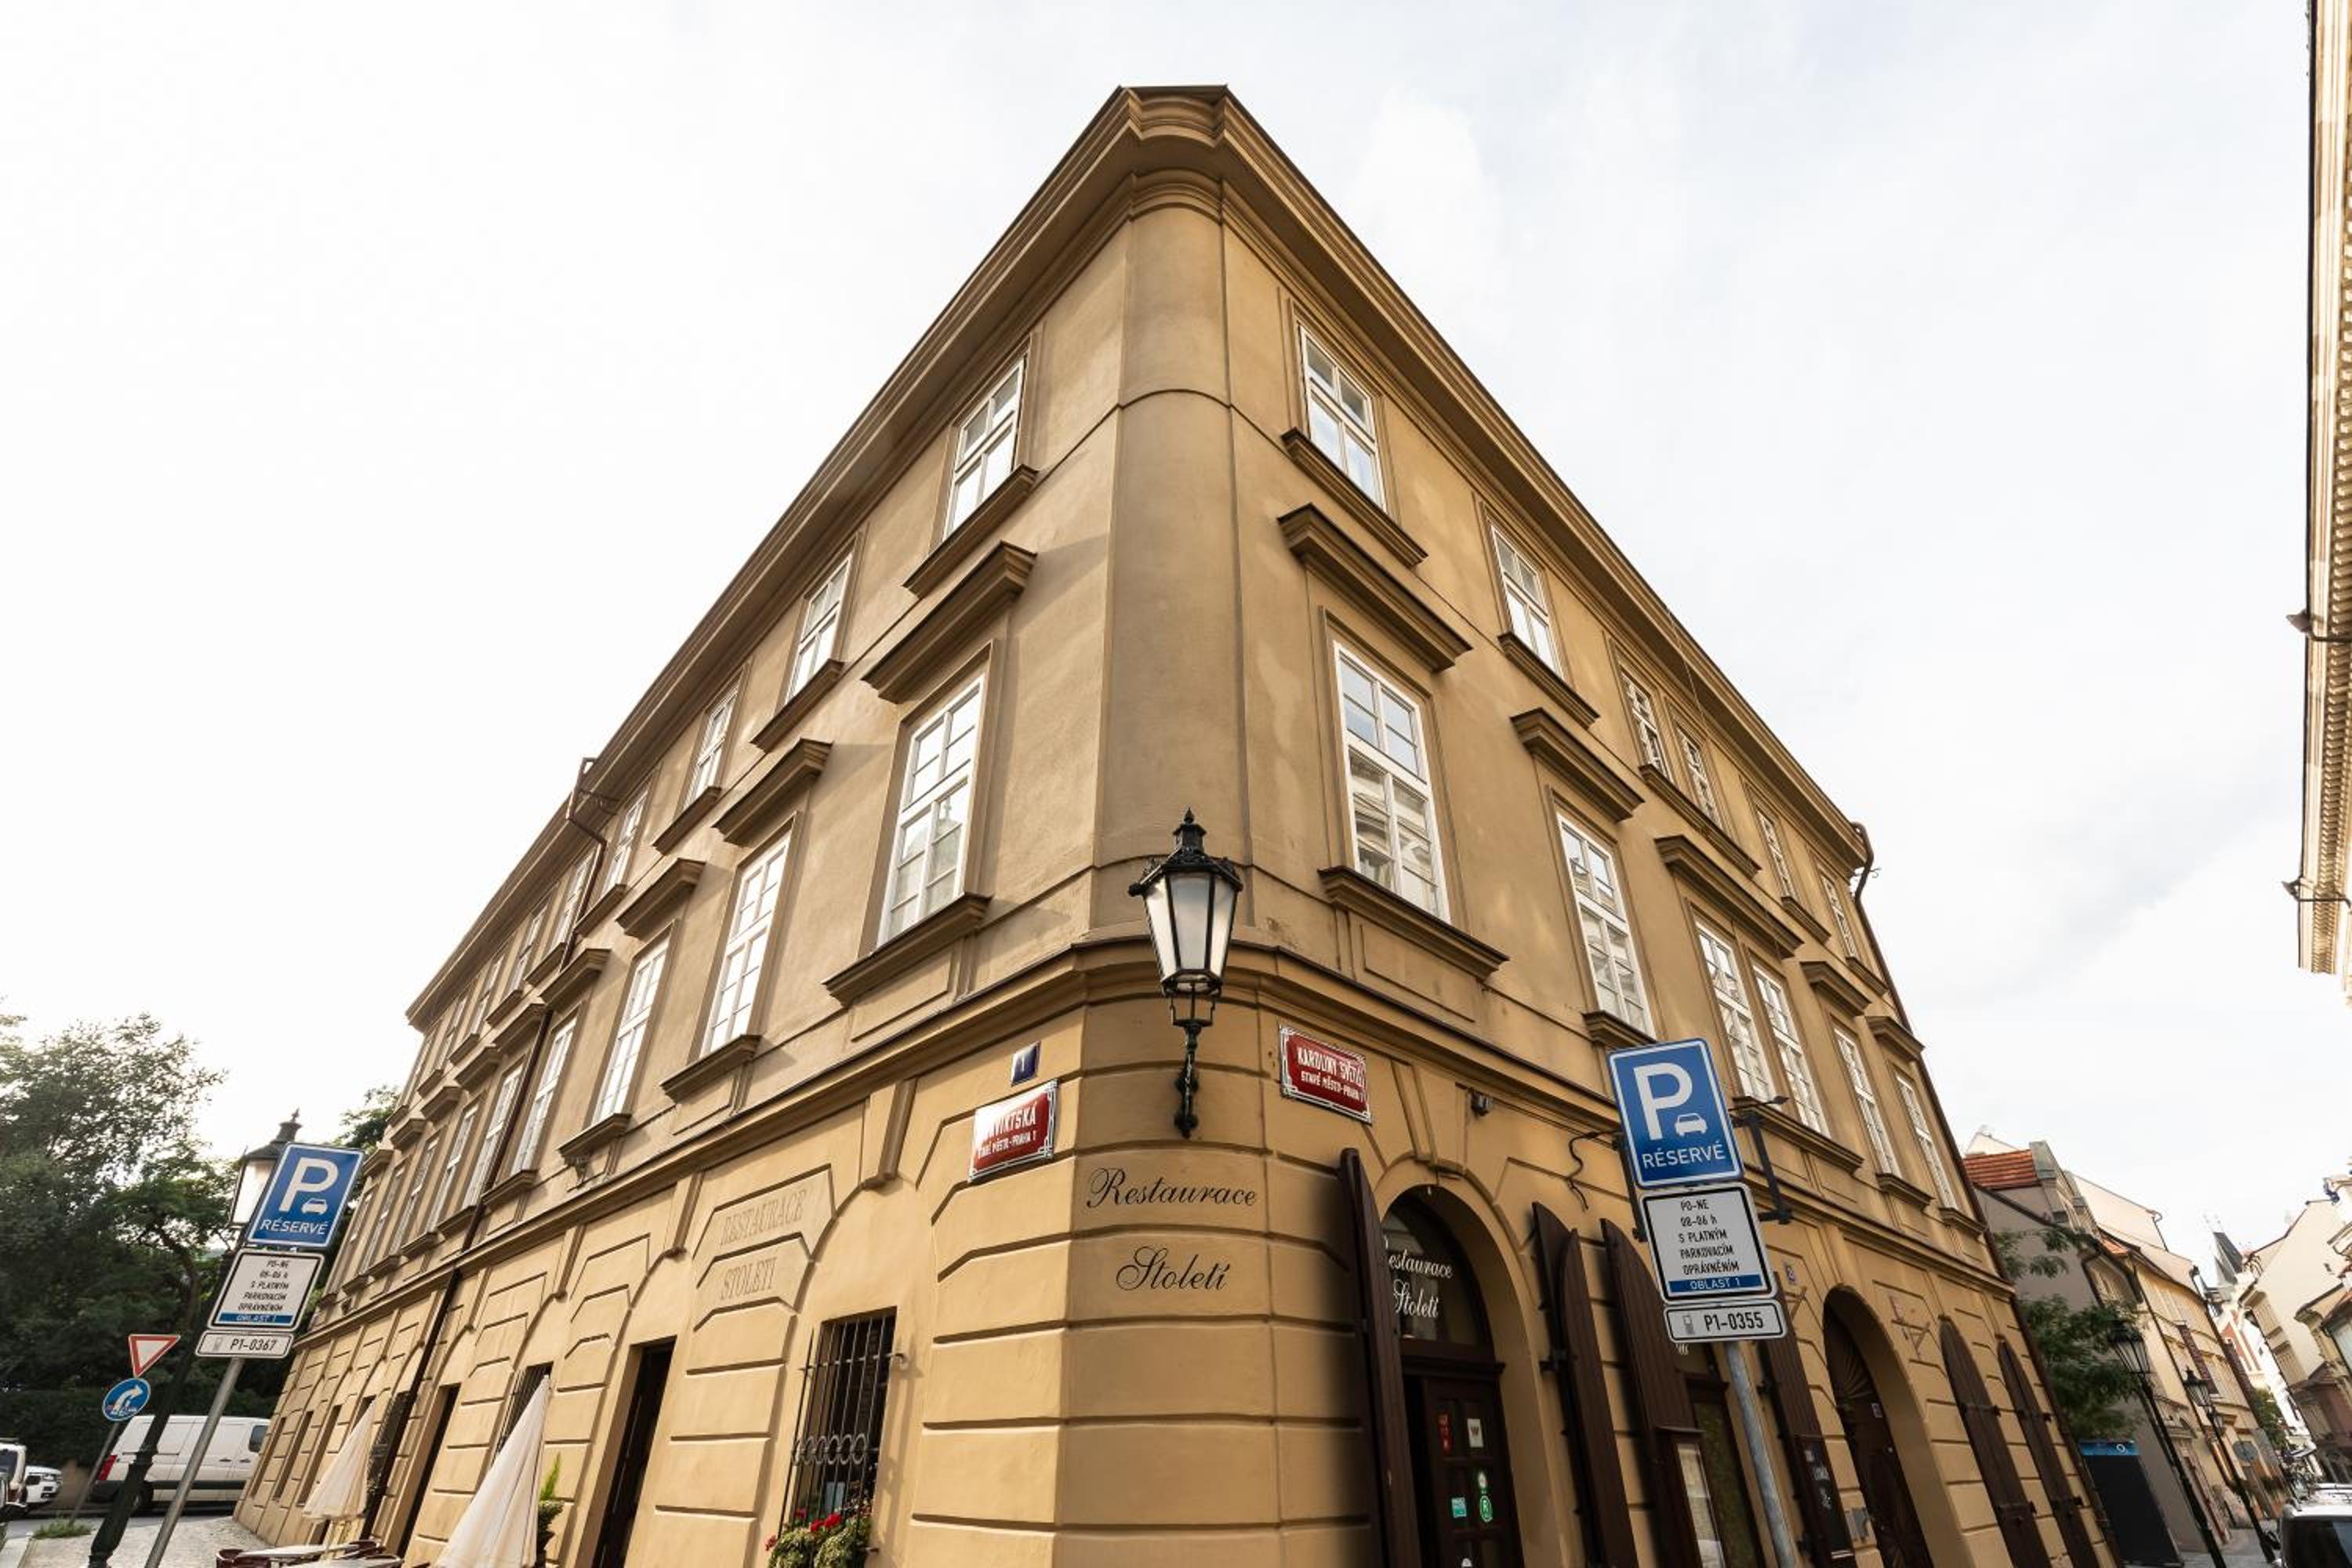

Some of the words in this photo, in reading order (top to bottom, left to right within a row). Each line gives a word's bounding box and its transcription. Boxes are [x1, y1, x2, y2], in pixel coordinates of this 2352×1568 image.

[1633, 1062, 1693, 1141] P
[1642, 1141, 1726, 1168] RÉSERVÉ
[279, 1157, 339, 1213] P
[1087, 1167, 1257, 1208] Restaurace
[1680, 1199, 1710, 1211] PO-NE
[260, 1217, 329, 1235] RÉSERVÉ
[720, 1189, 807, 1245] RESTAURACE
[1679, 1233, 1685, 1243] S
[1688, 1228, 1728, 1243] PLATNÝM
[1385, 1236, 1453, 1279] estaurace
[1680, 1243, 1734, 1259] PARKOVACÍM
[1116, 1246, 1230, 1291] Století
[1682, 1259, 1740, 1276] OPRÁVNĚNÍM
[1690, 1278, 1730, 1290] OBLAST
[1735, 1277, 1740, 1287] 1
[1704, 1312, 1764, 1331] P1-0355
[230, 1338, 278, 1352] P1-0367
